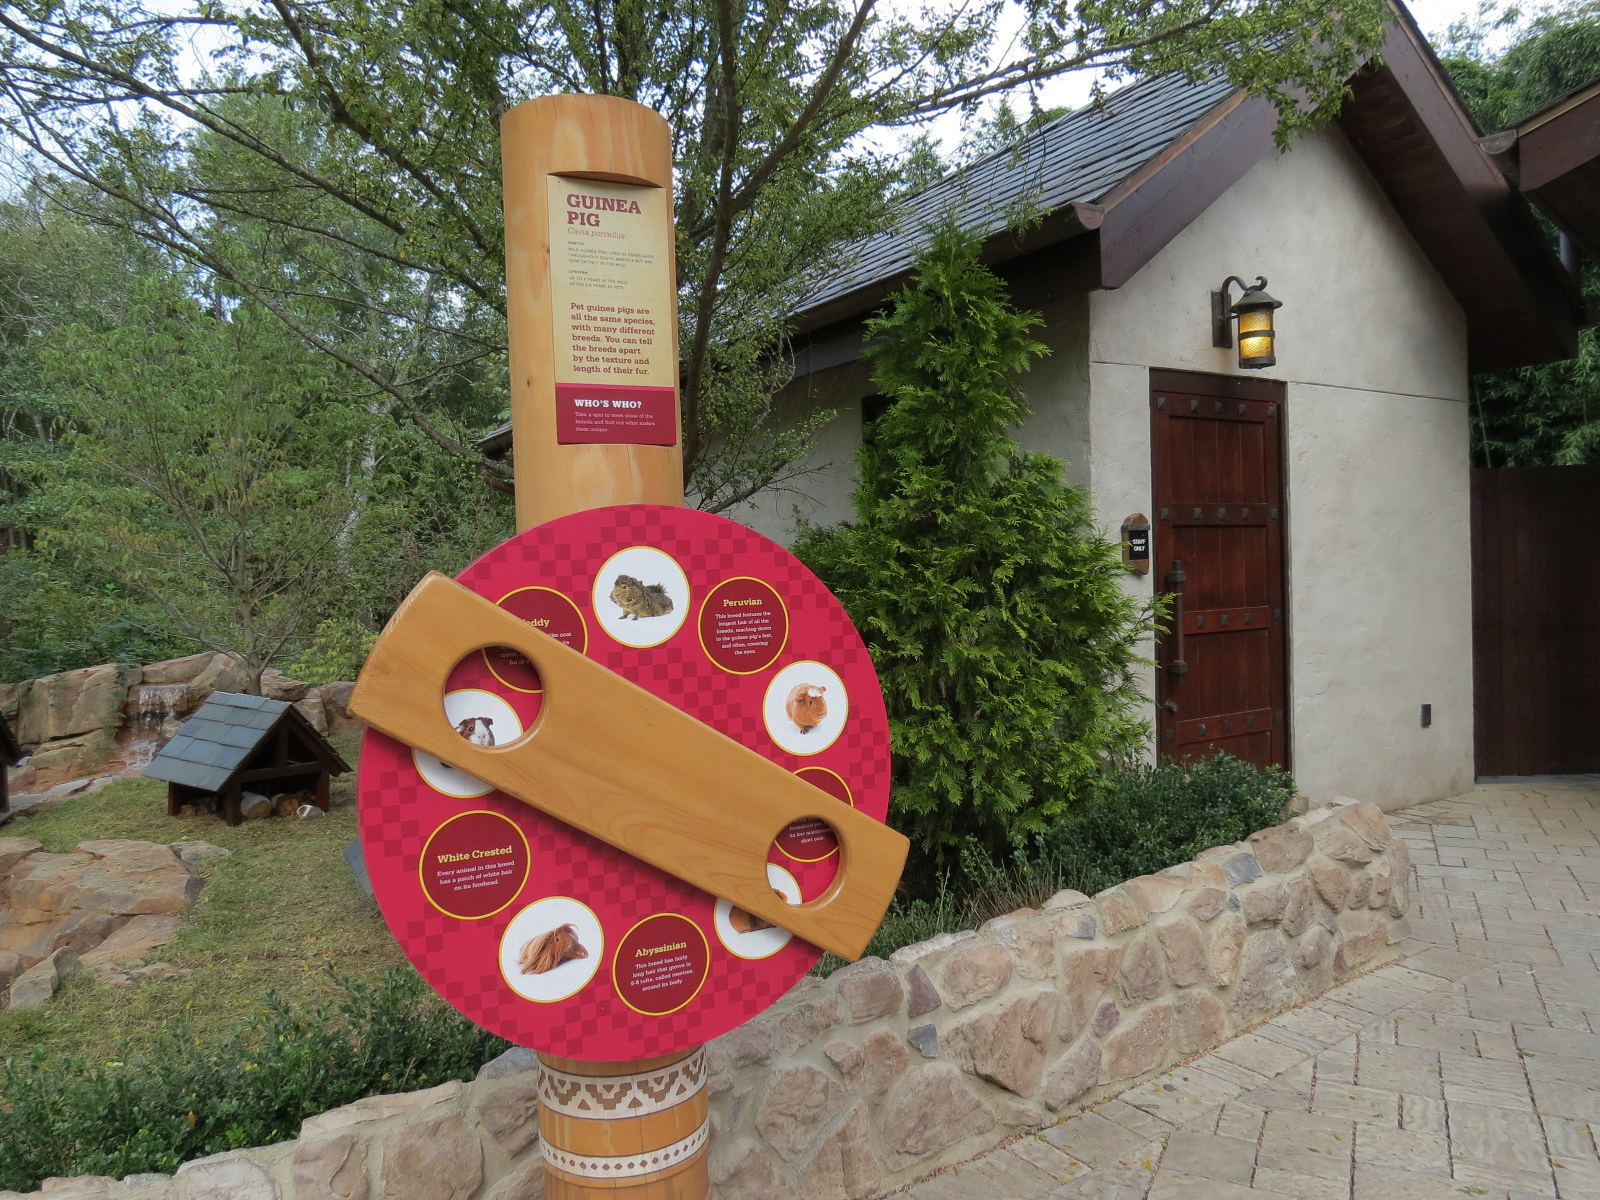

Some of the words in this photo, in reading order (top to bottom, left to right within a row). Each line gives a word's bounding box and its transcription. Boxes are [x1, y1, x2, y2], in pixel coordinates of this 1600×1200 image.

[567, 194, 641, 214] GUINEA
[567, 211, 600, 227] PIG
[568, 227, 589, 236] Cavia
[591, 230, 625, 239] porcellus
[617, 306, 634, 314] pigs
[624, 318, 655, 326] species,
[620, 327, 655, 335] different
[572, 334, 602, 342] breeds.
[589, 345, 616, 353] breeds
[573, 354, 583, 362] by
[573, 365, 600, 373] length
[574, 399, 609, 408] WHO'S
[723, 598, 762, 607] Peruvian
[523, 618, 550, 627] ddy
[437, 853, 470, 863] White
[472, 845, 512, 858] Crested
[458, 875, 474, 883] patch
[472, 879, 499, 888] forehead.
[635, 941, 686, 957] Abyssinian
[642, 983, 660, 991] around
